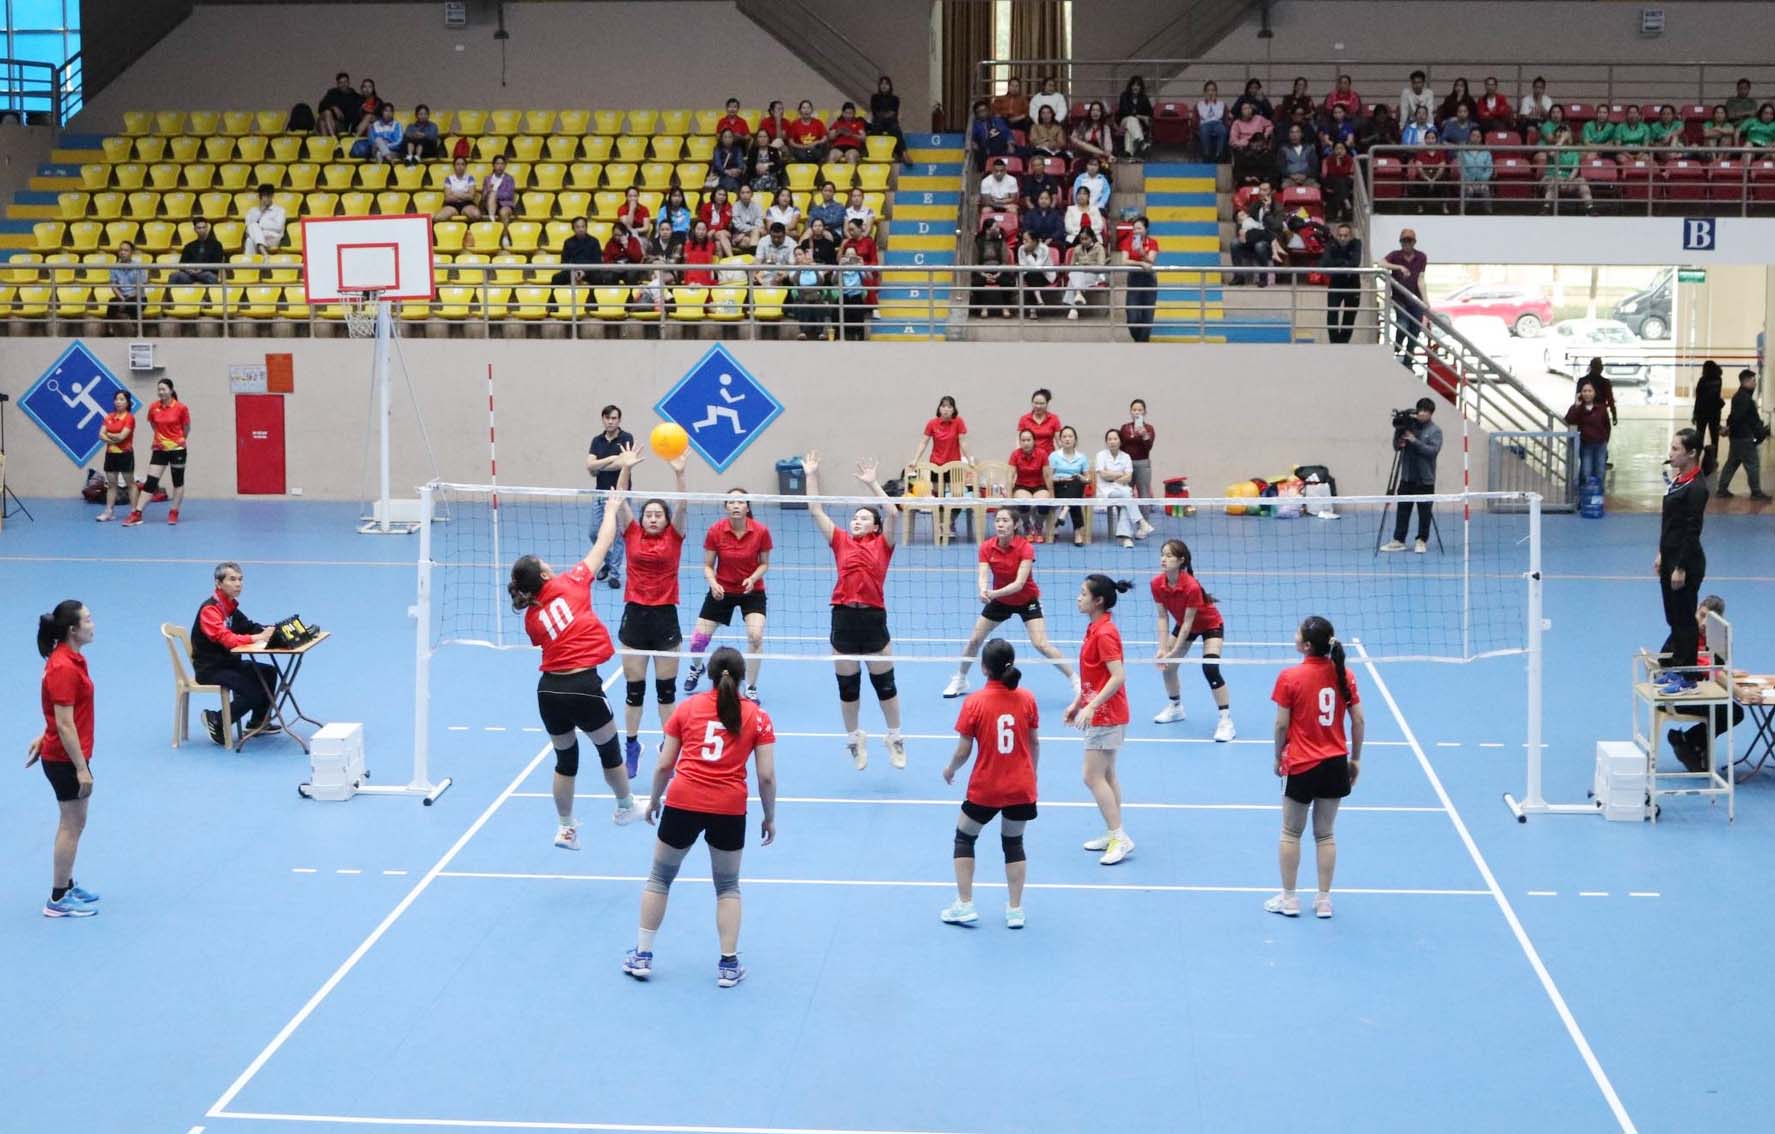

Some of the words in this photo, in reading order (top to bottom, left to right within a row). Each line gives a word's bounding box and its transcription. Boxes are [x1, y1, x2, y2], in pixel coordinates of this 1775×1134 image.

[931, 135, 941, 146] G
[928, 164, 937, 176] F
[923, 193, 933, 204] E
[919, 222, 930, 233] D
[1687, 220, 1711, 248] B
[914, 253, 924, 264] C
[904, 321, 915, 333] A
[539, 596, 574, 641] 10
[1318, 687, 1336, 727] 9
[997, 713, 1015, 754] 6
[701, 720, 727, 762] 5
